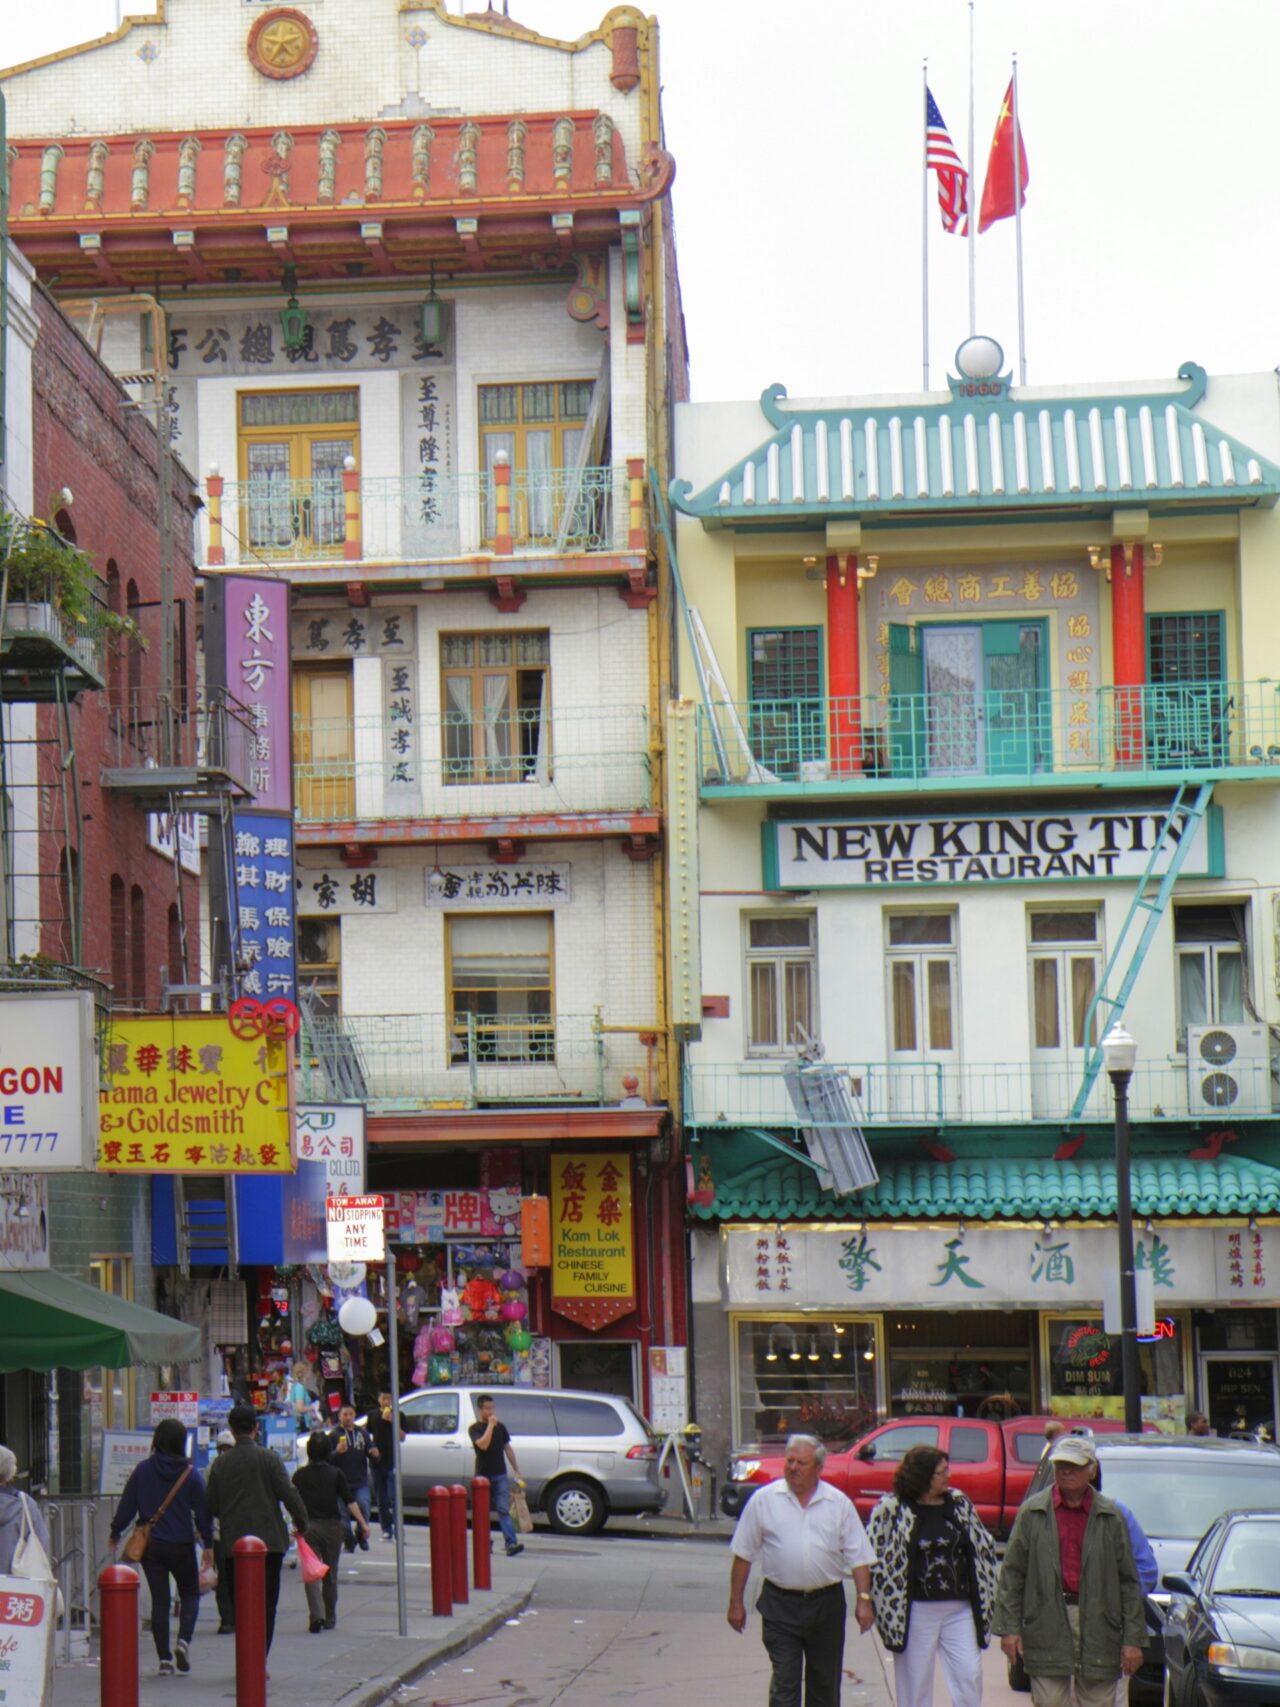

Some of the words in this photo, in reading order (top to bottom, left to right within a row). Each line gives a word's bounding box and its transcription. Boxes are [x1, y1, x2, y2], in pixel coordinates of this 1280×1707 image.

[889, 571, 1080, 607] 協善工商總會
[242, 592, 274, 793] 東方事務所
[791, 823, 917, 863] NEW
[928, 817, 1079, 858] KING
[864, 853, 1122, 883] RESTAURANT
[264, 837, 293, 995] 理財保險行
[163, 1078, 251, 1110] Jewelry
[127, 1107, 245, 1135] Goldsmith
[331, 1198, 349, 1207] TOW
[355, 1197, 379, 1207] AWAY
[328, 1207, 345, 1222] NO
[346, 1209, 382, 1221] STOPPING
[345, 1224, 366, 1235] ANY
[561, 1228, 591, 1242] Kam
[597, 1228, 620, 1242] Lok
[344, 1236, 369, 1248] TIME
[558, 1243, 626, 1258] Restaurant
[557, 1260, 604, 1270] CHINESE
[573, 1271, 609, 1281] FAMILY
[584, 1282, 627, 1293] CUISINE
[1064, 1370, 1085, 1383] DIM
[1087, 1370, 1110, 1383] SUM
